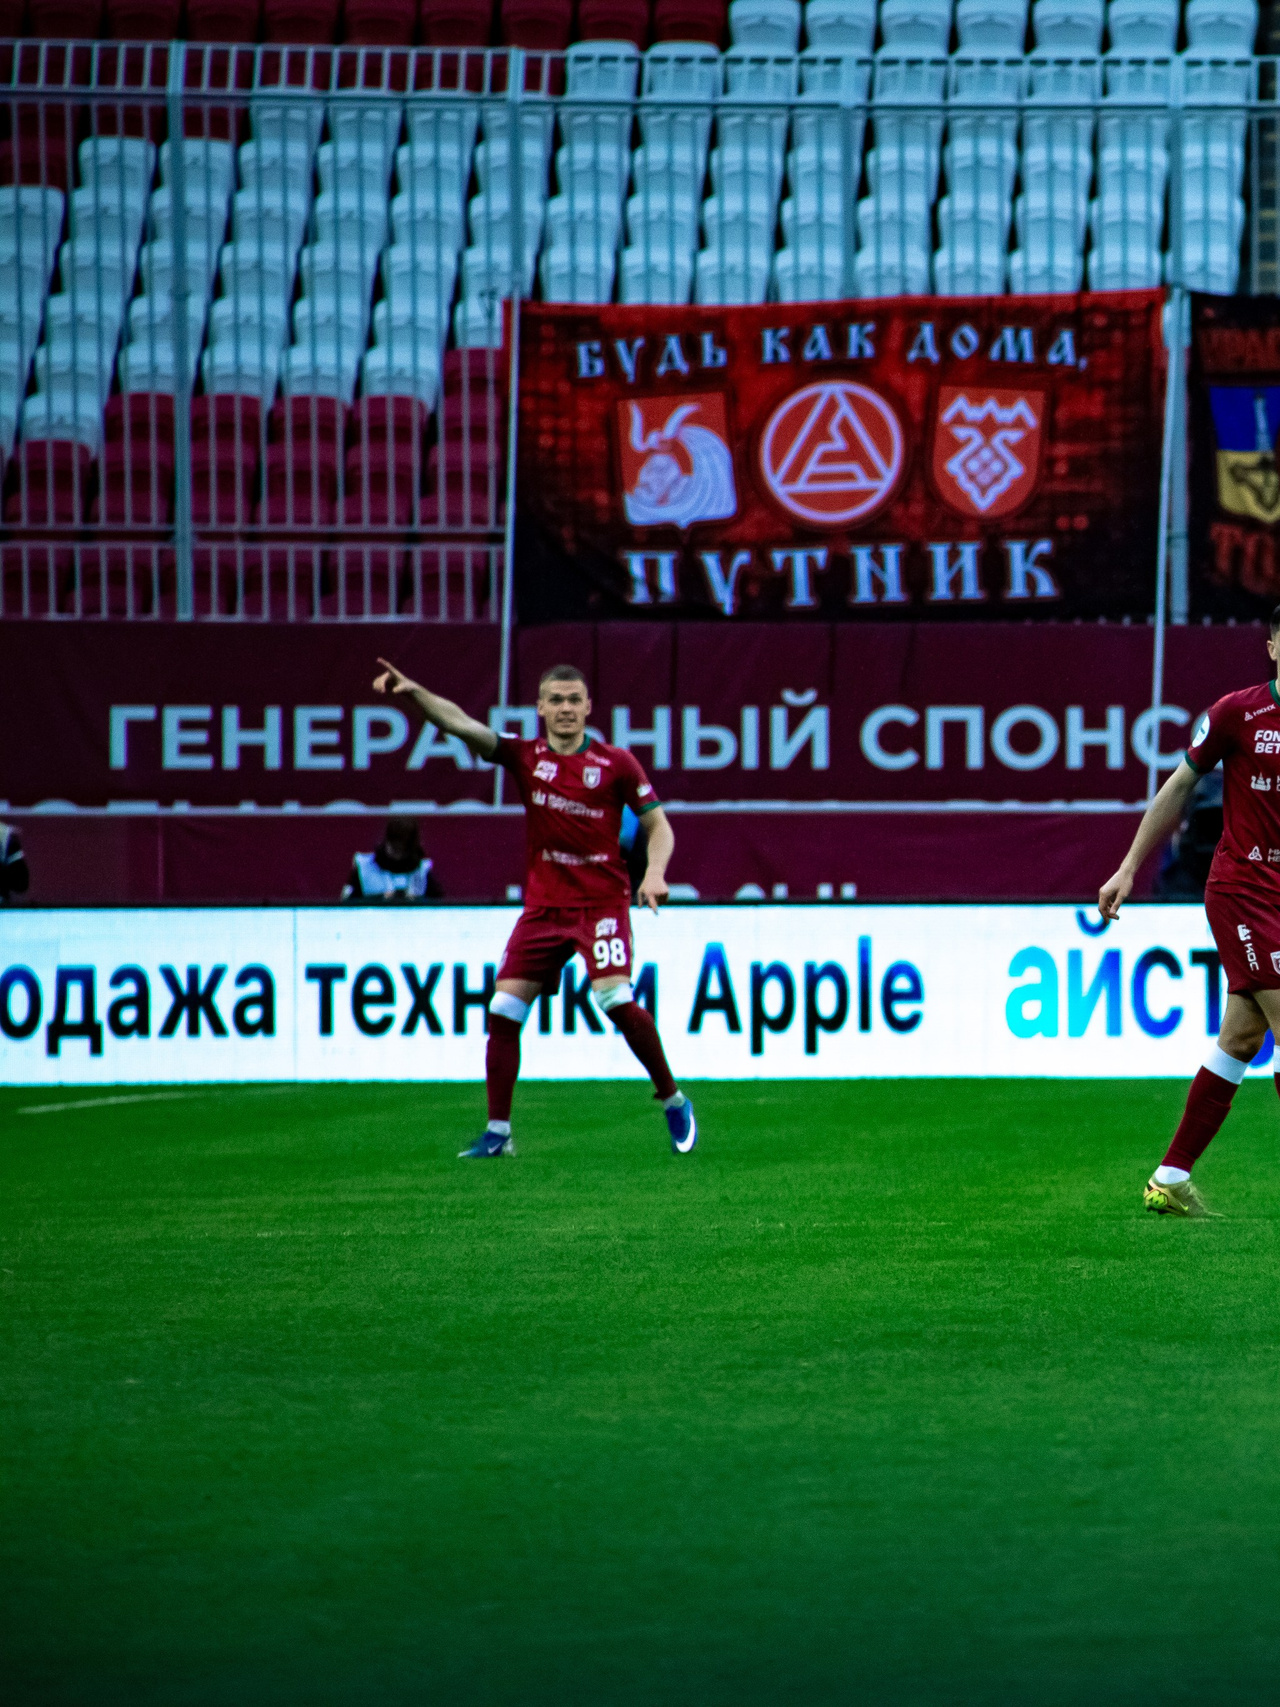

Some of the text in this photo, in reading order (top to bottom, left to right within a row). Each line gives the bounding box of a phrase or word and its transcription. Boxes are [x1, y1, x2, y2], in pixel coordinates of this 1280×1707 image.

[576, 321, 1088, 384] БУДЬ КАК ДОМА,
[620, 538, 1061, 617] ПУТНИК
[109, 690, 830, 770] ГЕНЕРАЛНЫЙ
[593, 937, 627, 970] 98
[0, 963, 277, 1058] одажа
[688, 934, 925, 1056] Apple
